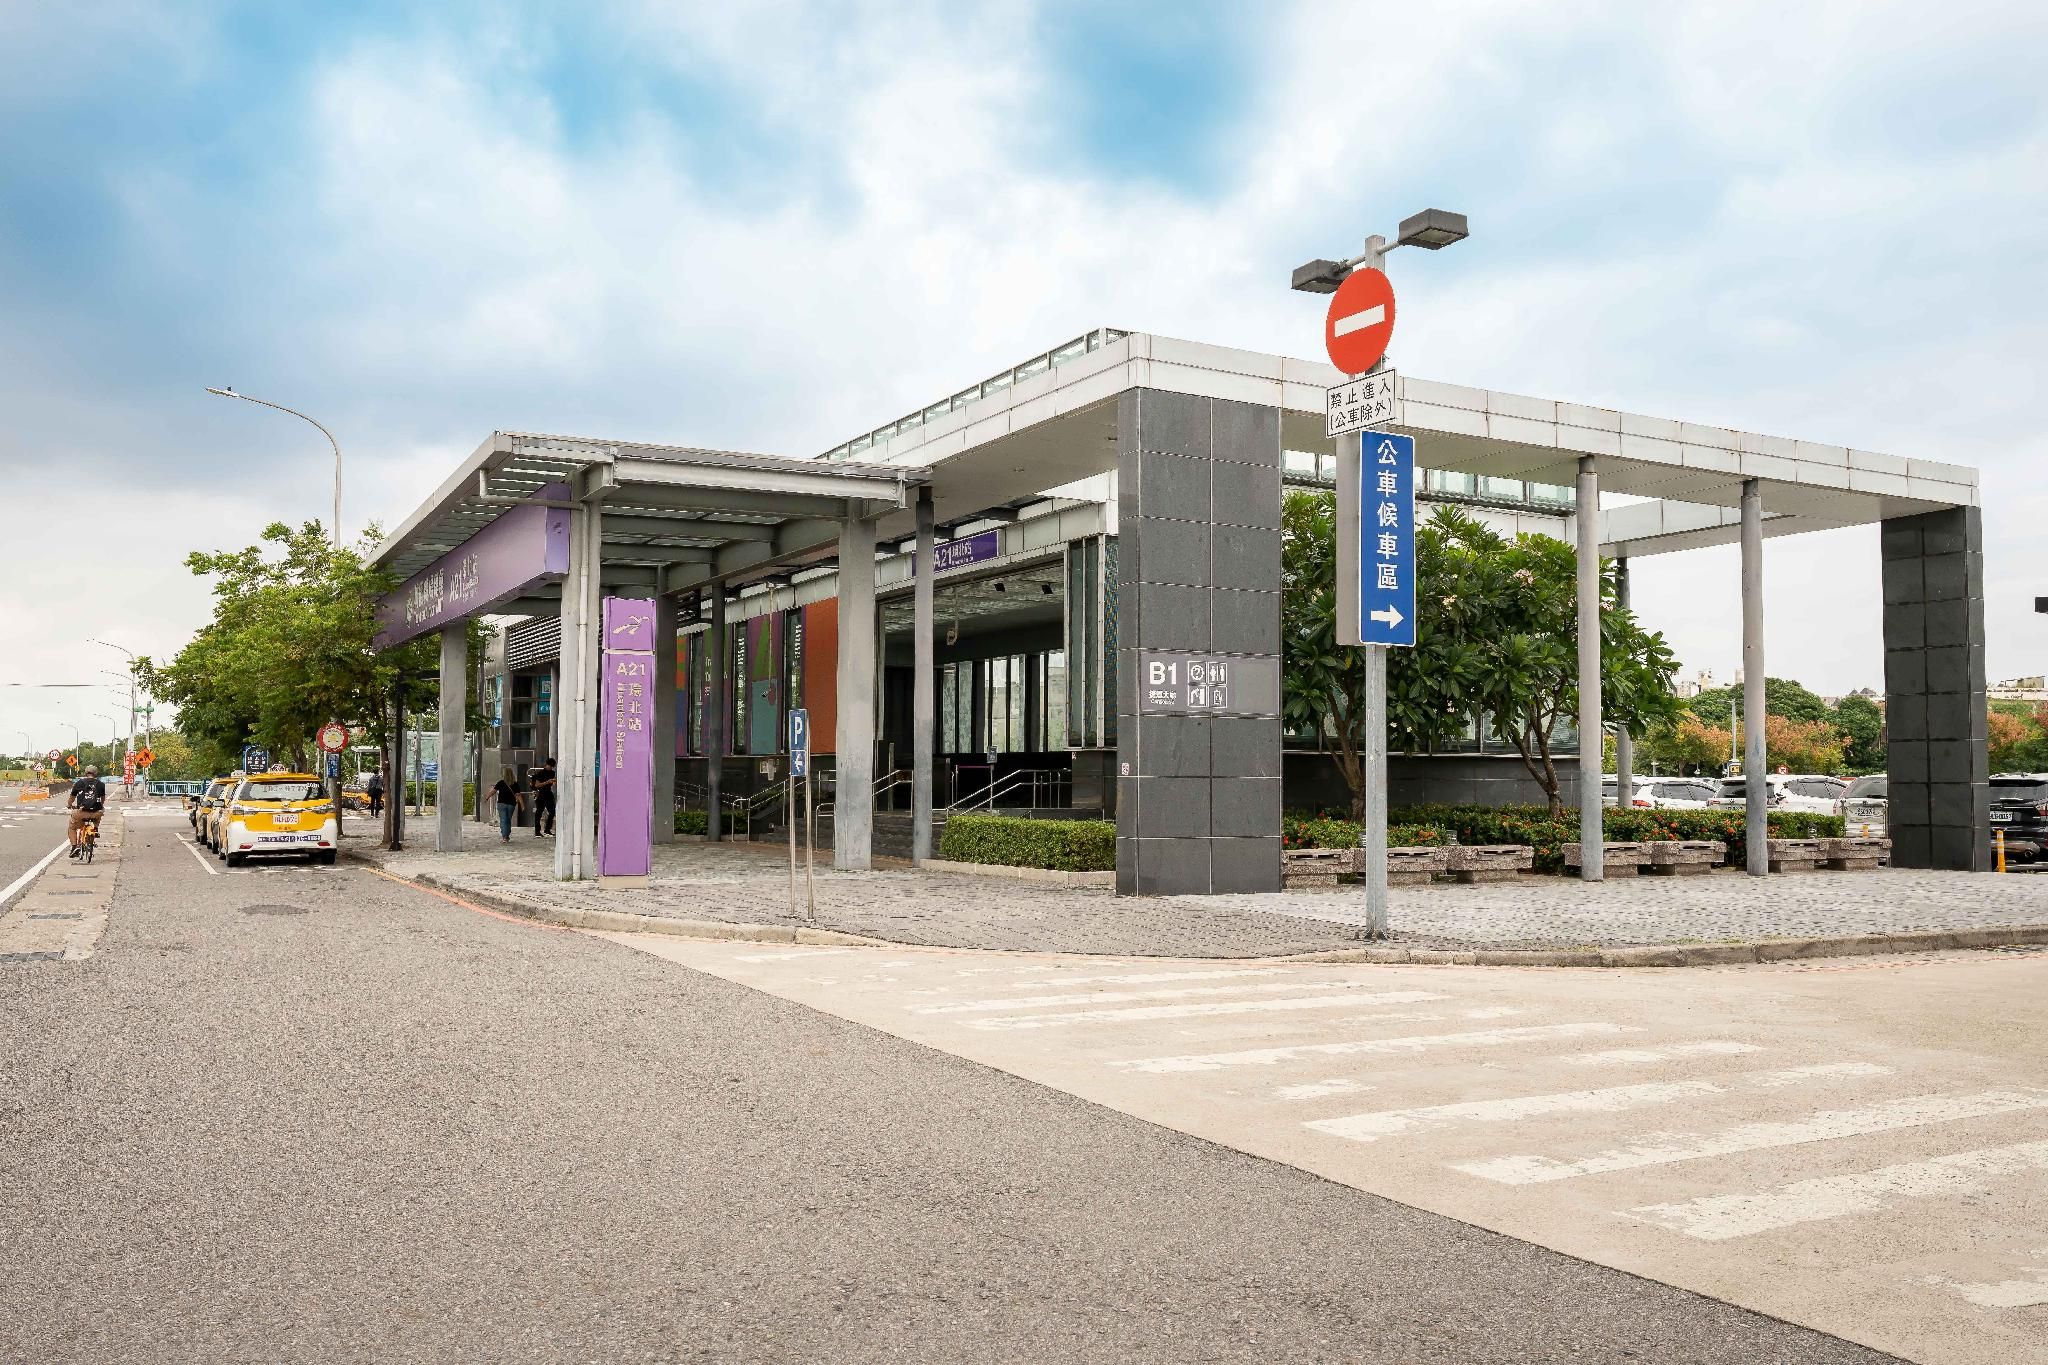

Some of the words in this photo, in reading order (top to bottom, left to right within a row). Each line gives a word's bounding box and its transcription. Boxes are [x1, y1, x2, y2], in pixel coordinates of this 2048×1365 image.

[1331, 378, 1391, 409] 禁止進入
[1331, 398, 1392, 430] (公車除外)
[1377, 439, 1399, 590] 公車候車區
[934, 547, 952, 568] A21
[616, 662, 646, 676] A21
[1149, 661, 1177, 685] B1
[794, 716, 803, 745] P
[615, 731, 626, 769] Station
